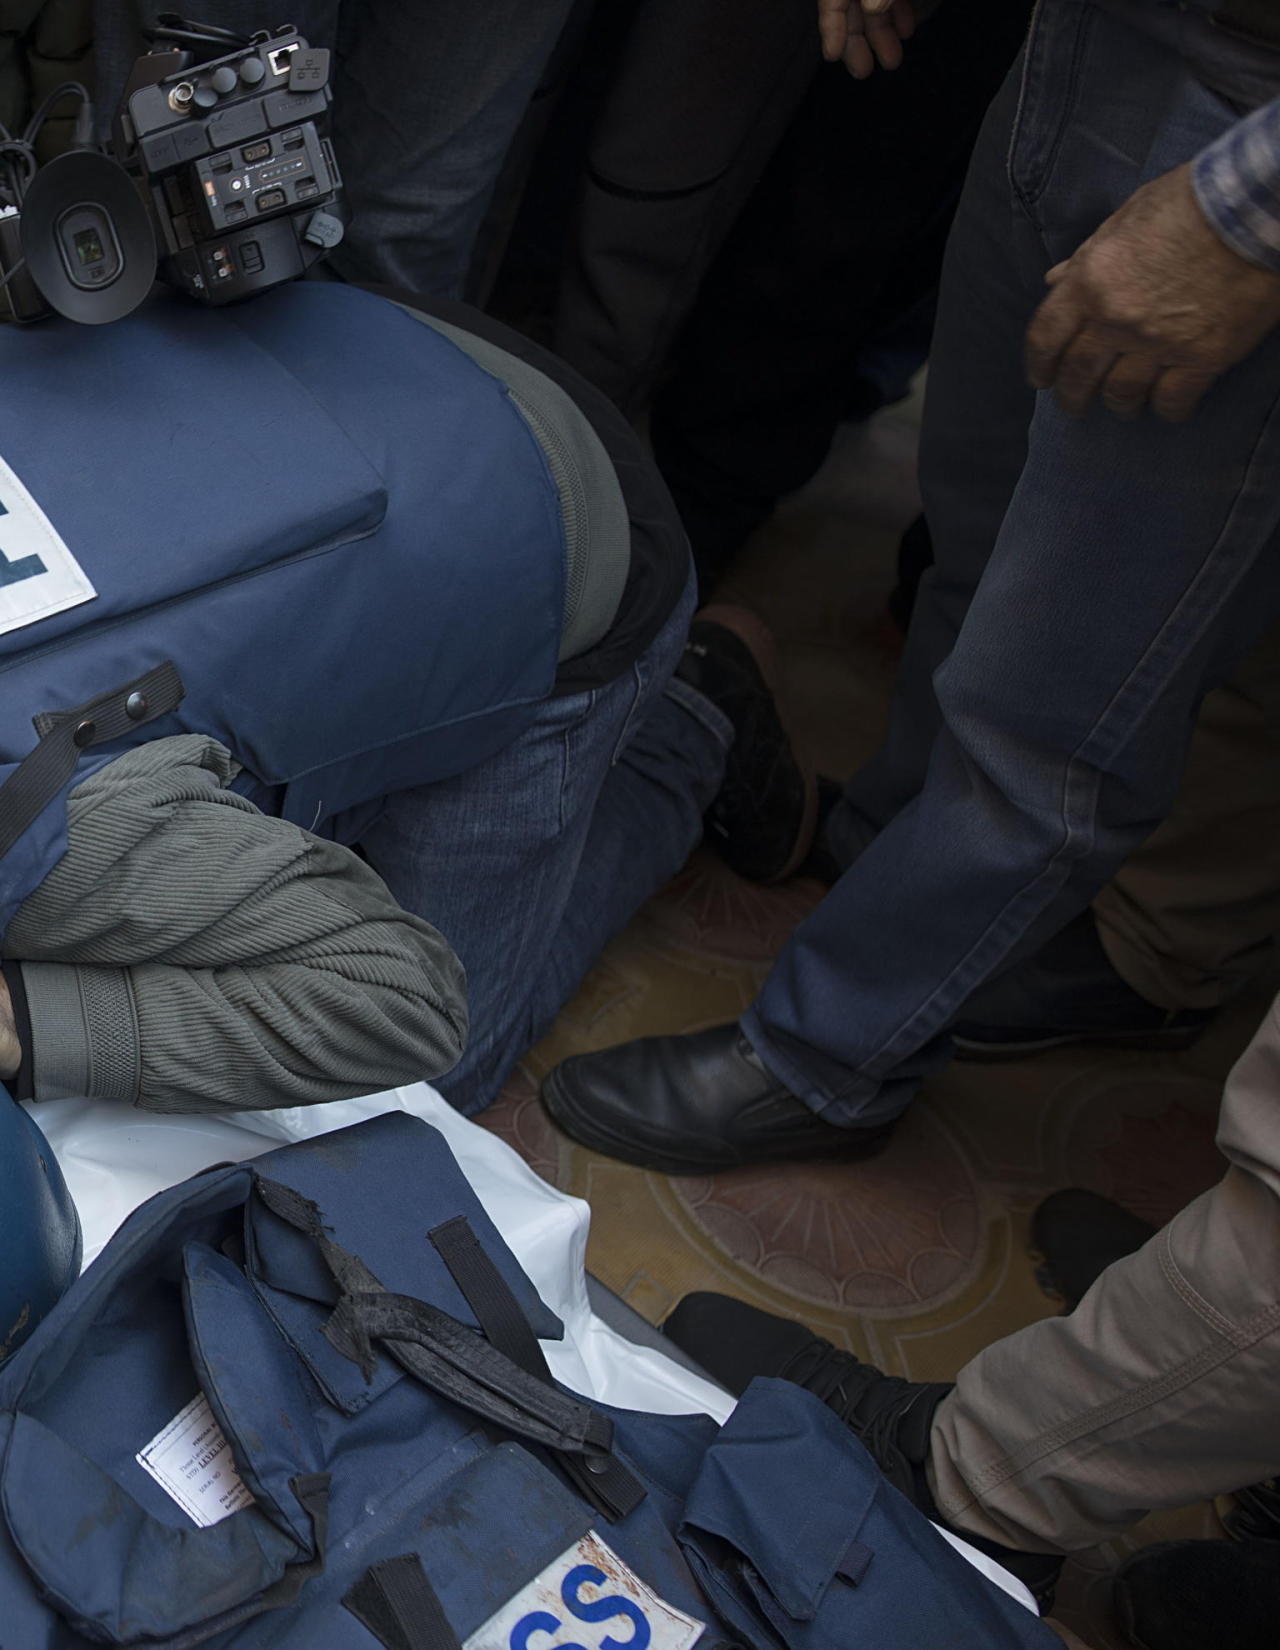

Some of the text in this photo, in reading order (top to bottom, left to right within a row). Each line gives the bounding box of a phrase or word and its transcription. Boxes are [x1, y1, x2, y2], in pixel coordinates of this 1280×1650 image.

[193, 1428, 212, 1446] PERSONAL
[192, 1446, 206, 1461] Level
[199, 1447, 219, 1469] LEVEL
[199, 1478, 215, 1494] SERIAL
